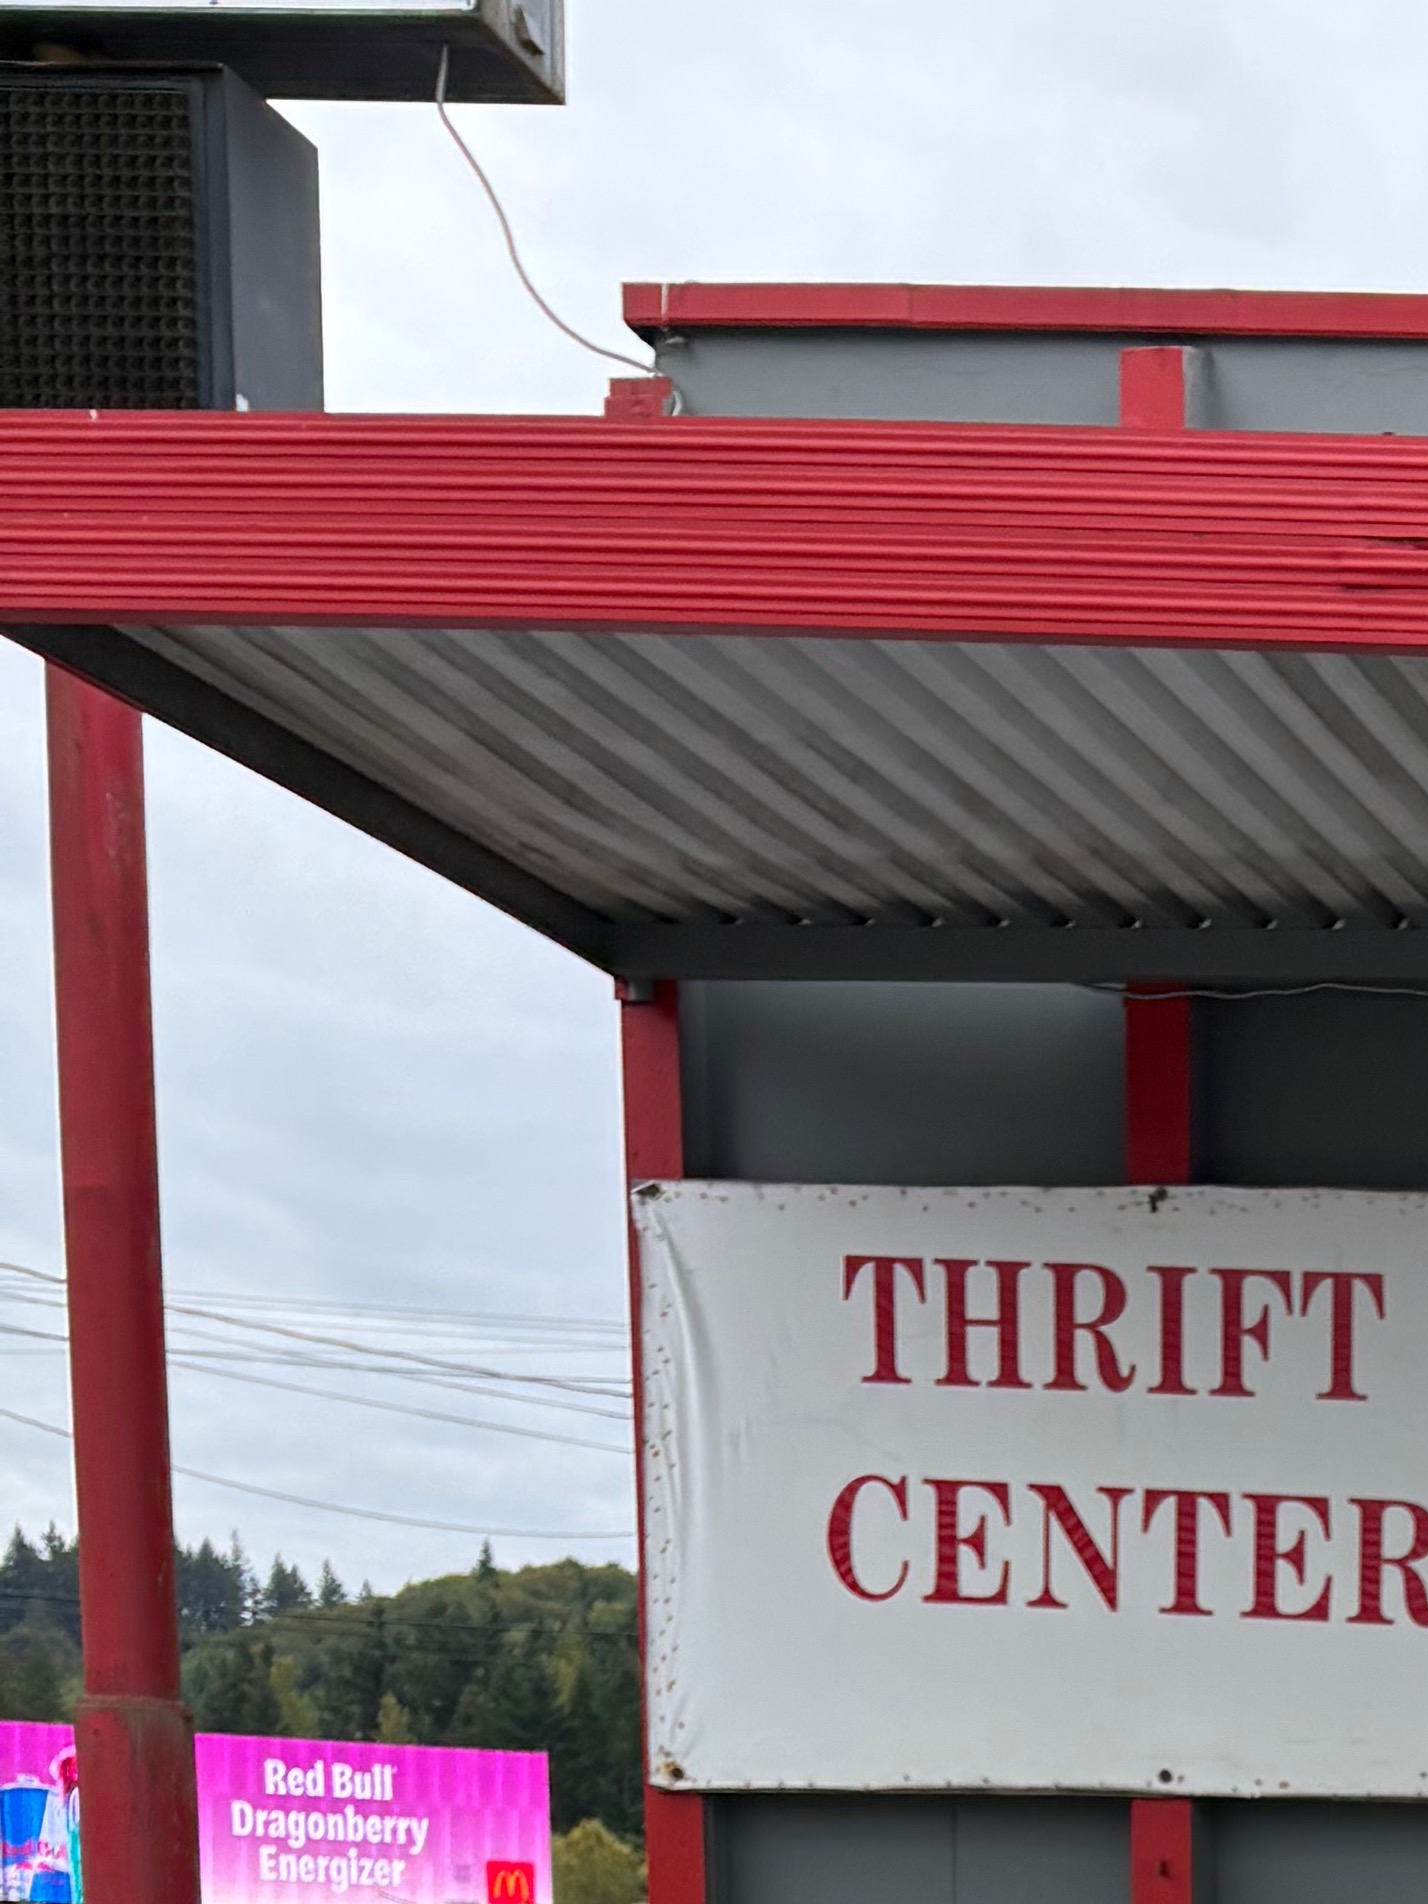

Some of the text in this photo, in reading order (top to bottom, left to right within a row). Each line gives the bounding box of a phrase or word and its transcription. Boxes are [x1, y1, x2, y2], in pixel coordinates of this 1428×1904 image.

[842, 1254, 1386, 1401] THRIFT
[263, 1758, 394, 1801] Red Bull
[230, 1799, 429, 1855] Dragonberry
[259, 1844, 405, 1893] Energizer
